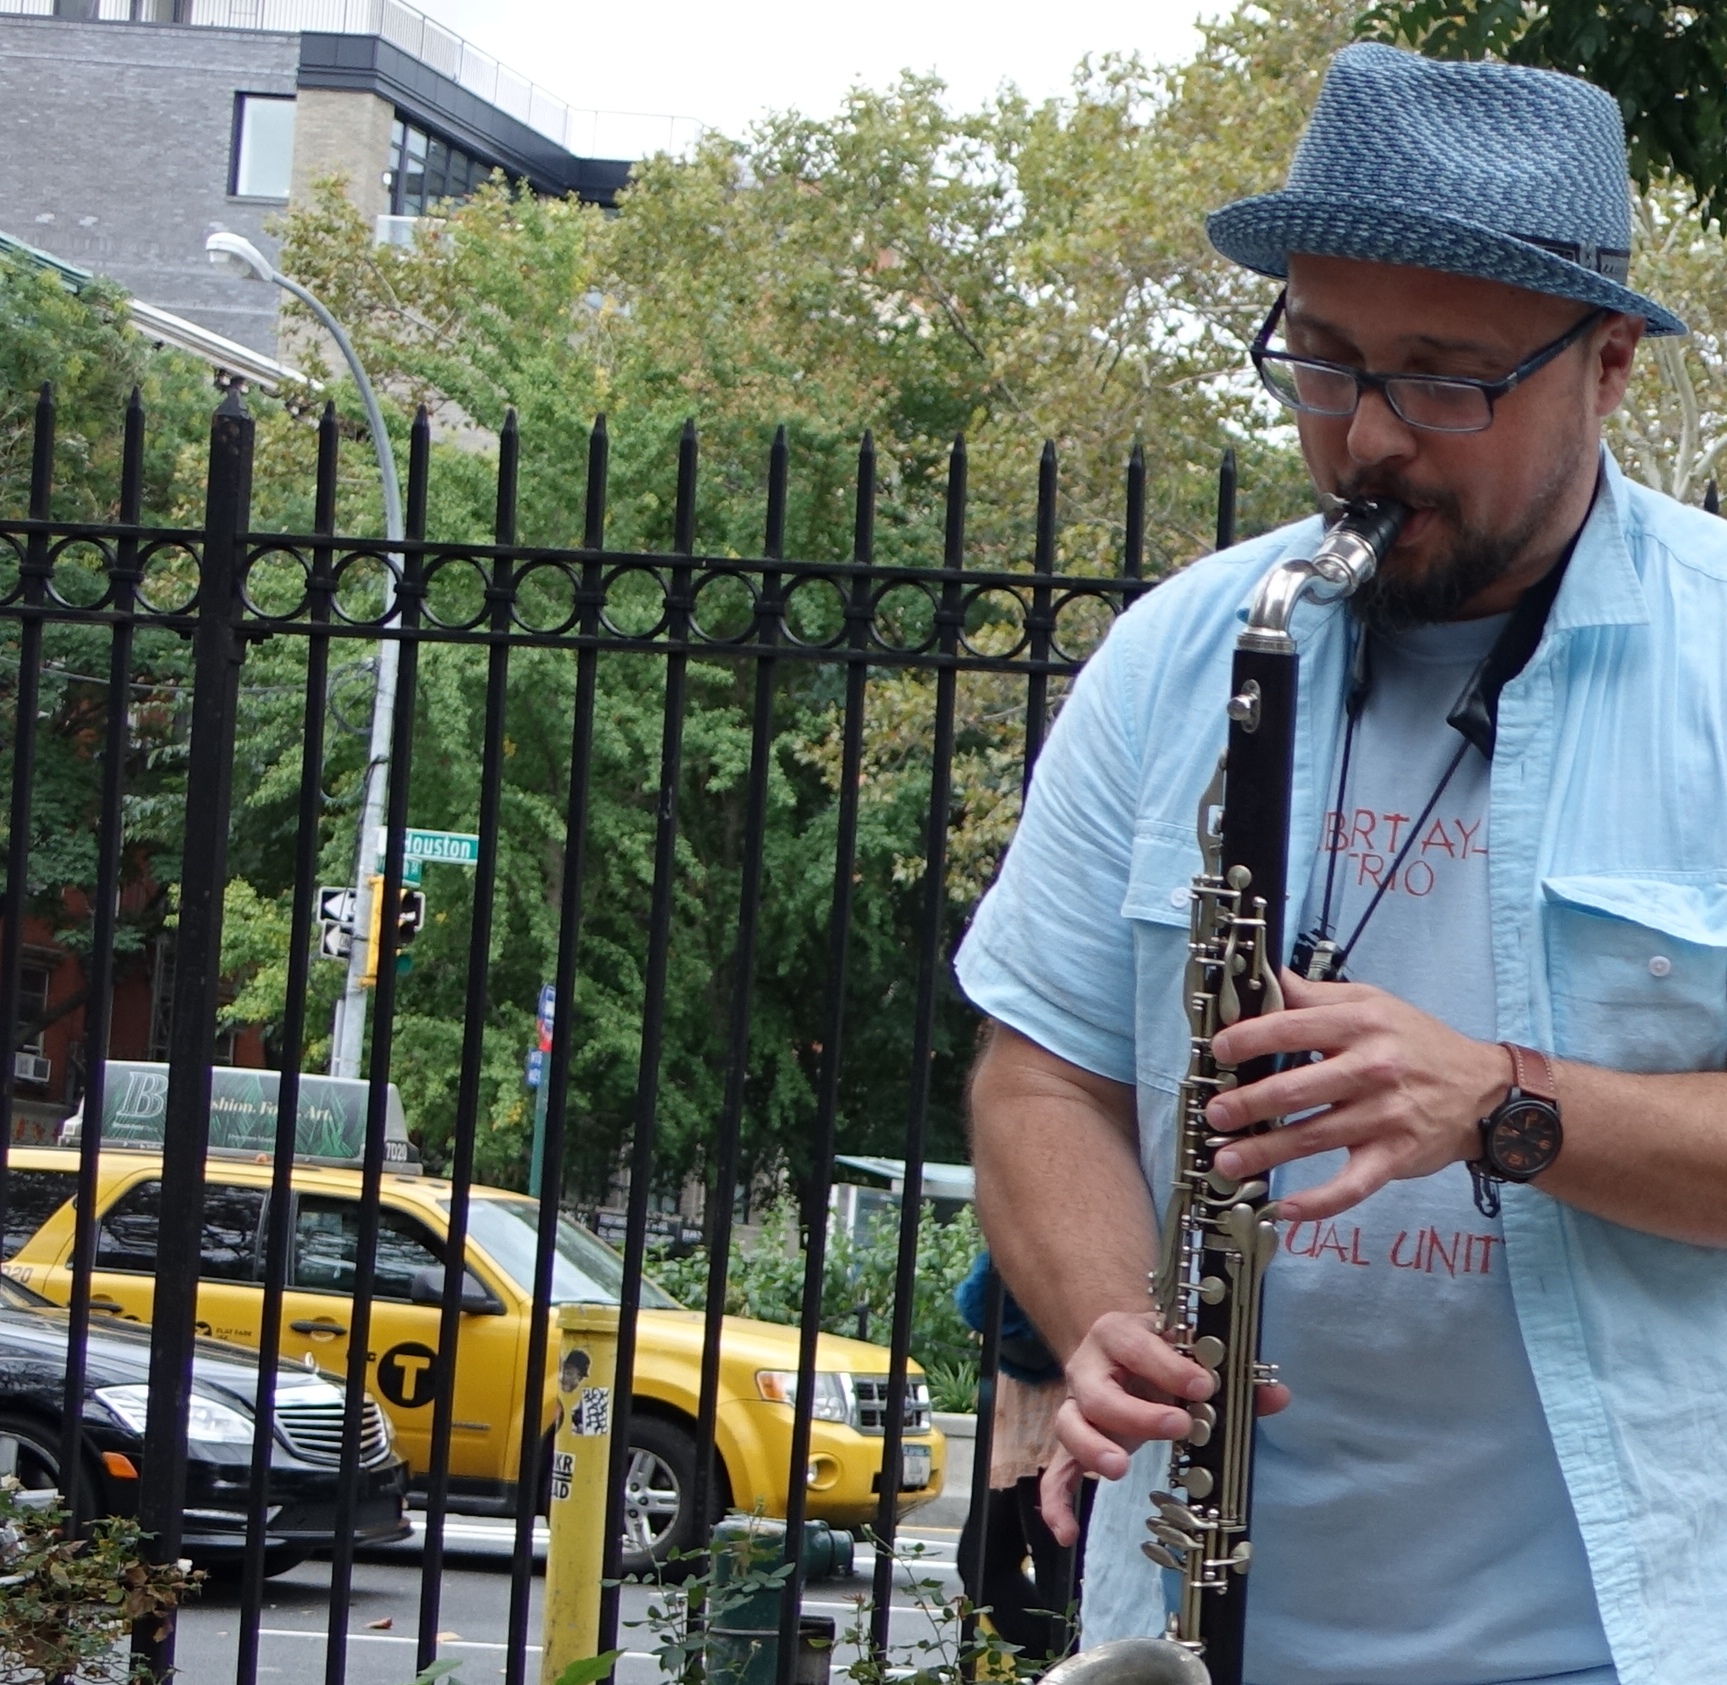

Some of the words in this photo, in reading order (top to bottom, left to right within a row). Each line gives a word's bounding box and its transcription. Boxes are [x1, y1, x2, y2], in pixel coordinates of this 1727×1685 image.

[1421, 817, 1487, 859] AY
[1349, 853, 1434, 897] RIO
[1390, 1225, 1504, 1278] UNIT
[393, 1353, 431, 1401] T
